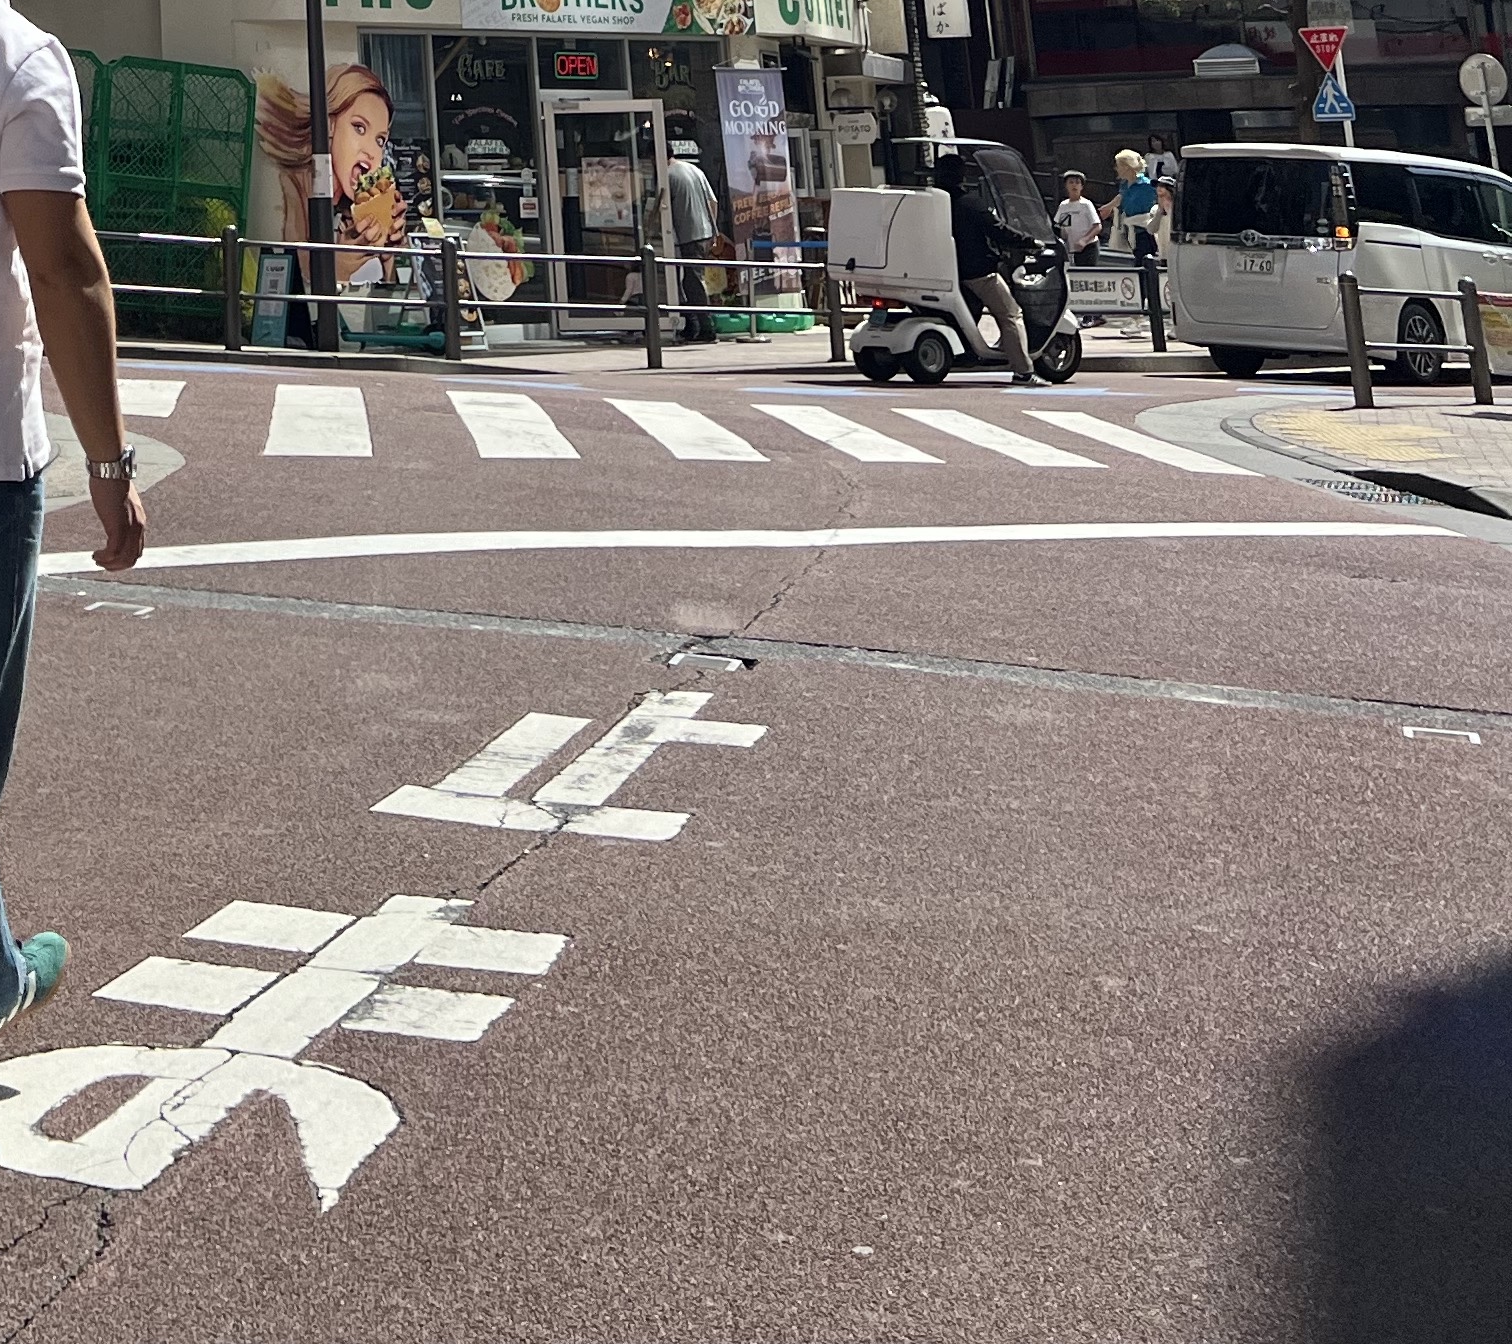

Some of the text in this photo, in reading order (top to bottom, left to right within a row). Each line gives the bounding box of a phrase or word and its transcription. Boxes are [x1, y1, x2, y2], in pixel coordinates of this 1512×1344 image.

[511, 12, 539, 23] FRESH
[541, 14, 578, 24] FALAFEL
[611, 16, 636, 26] SHOP
[1309, 32, 1340, 44] 止まれ
[1315, 44, 1337, 53] STOP
[557, 56, 598, 76] OPEN
[724, 120, 787, 136] MORNING
[838, 124, 872, 133] POTATO
